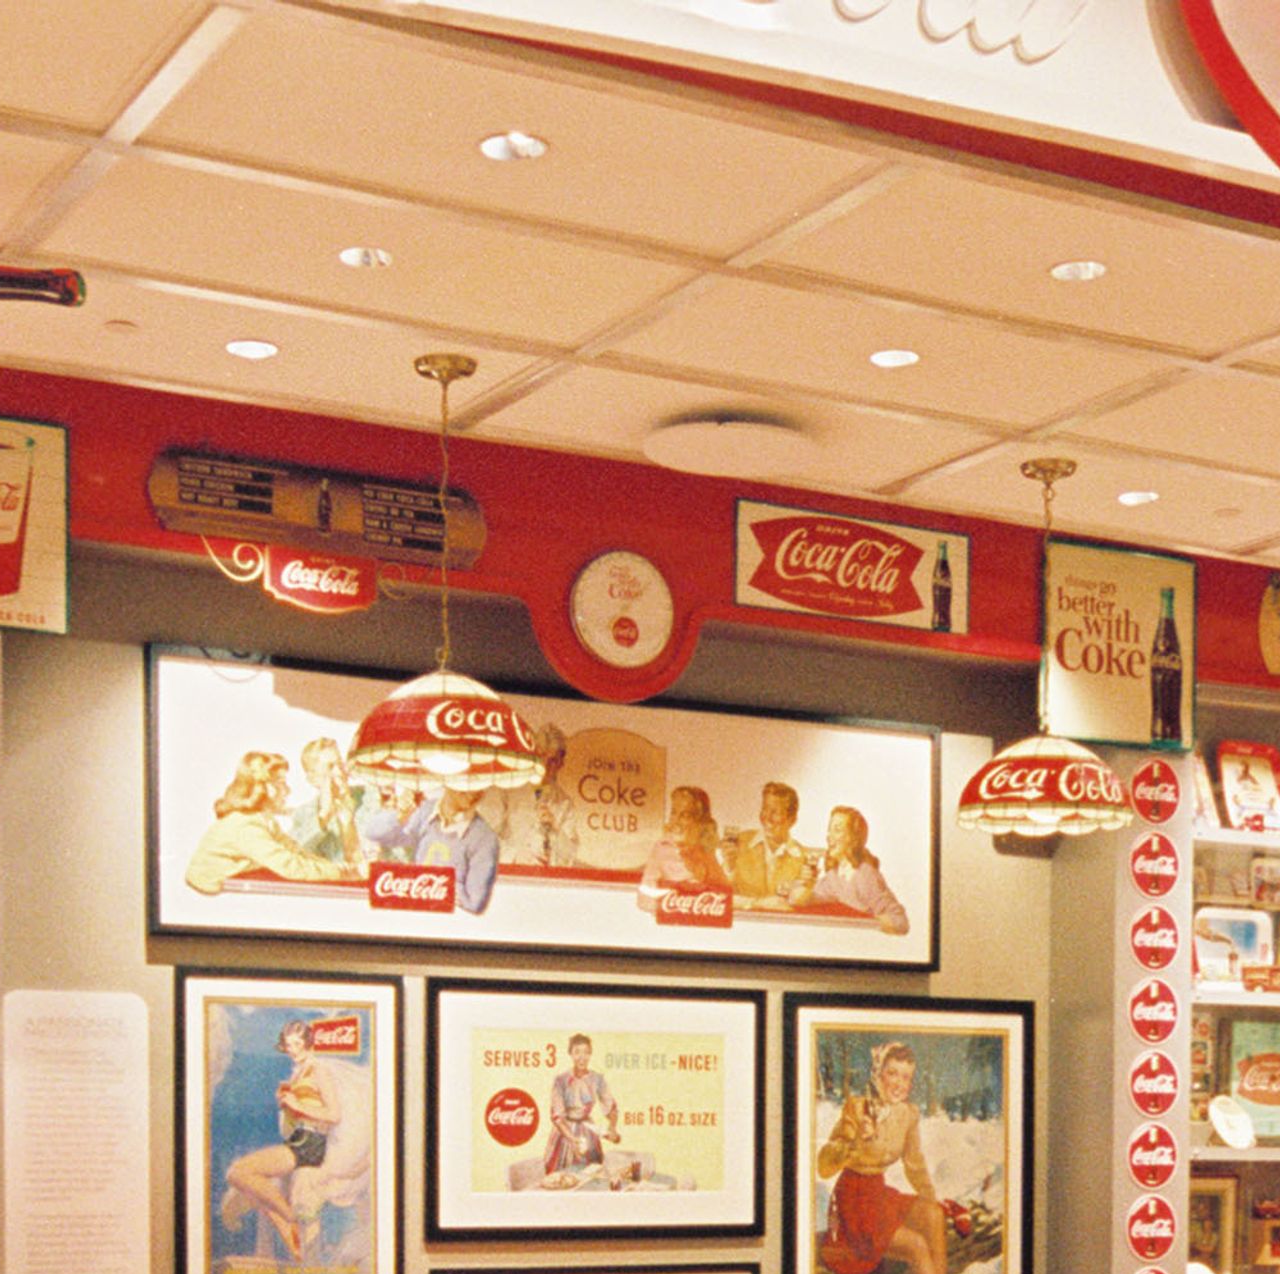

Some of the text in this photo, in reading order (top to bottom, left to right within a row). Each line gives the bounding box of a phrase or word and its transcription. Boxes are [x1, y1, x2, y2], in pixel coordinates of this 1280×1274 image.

[774, 527, 906, 593] Coca-Cola
[281, 559, 359, 596] Coca-Cola
[1057, 586, 1116, 616] better
[1082, 608, 1140, 643] with
[1055, 627, 1146, 679] Coke
[578, 774, 646, 808] Coke
[979, 763, 1123, 803] Coca-Cola
[587, 812, 639, 833] CLUB
[375, 871, 450, 901] Coca-Cola
[662, 888, 728, 917] Coca-Cola
[483, 1049, 541, 1068] SERVES
[545, 1043, 557, 1068] 3
[605, 1053, 641, 1070] OVER
[487, 1106, 535, 1127] Coca-Cola
[624, 1112, 644, 1125] BIG
[649, 1105, 664, 1125] 16
[690, 1112, 718, 1127] SIZE
